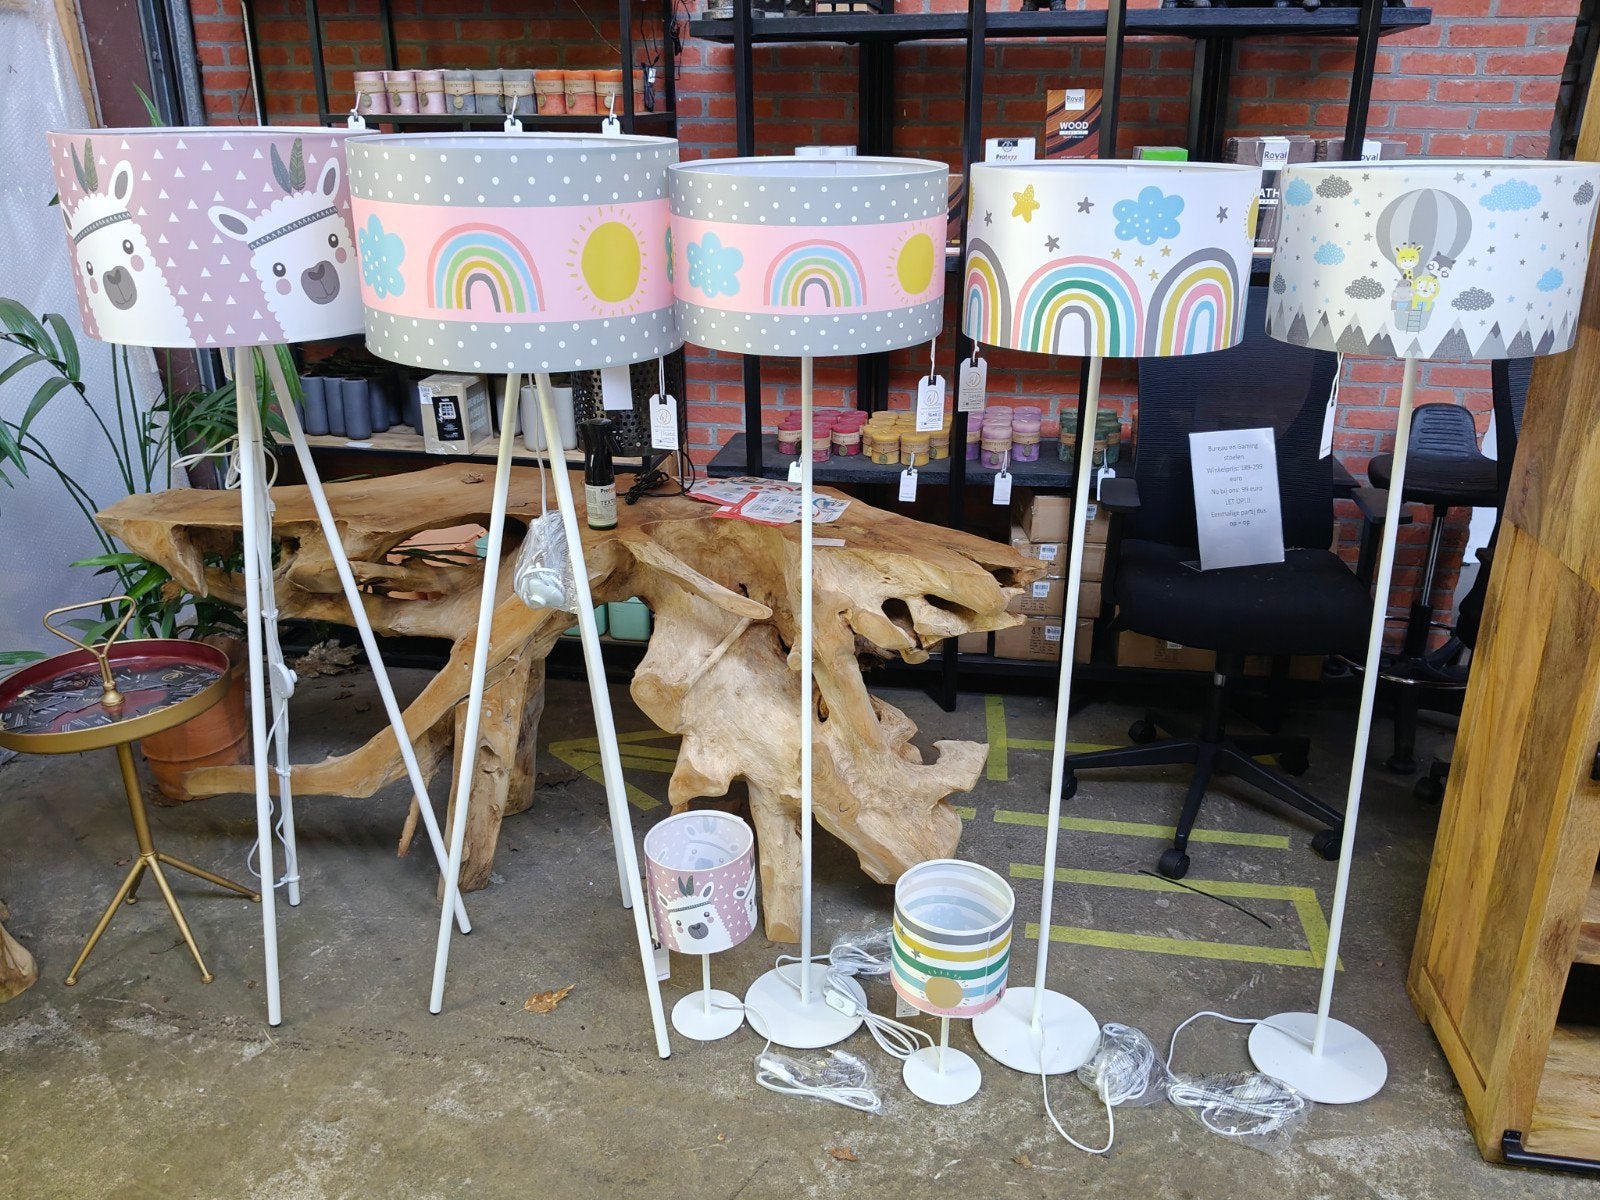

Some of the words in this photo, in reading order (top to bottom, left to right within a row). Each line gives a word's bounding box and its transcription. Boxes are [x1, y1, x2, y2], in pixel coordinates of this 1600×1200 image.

[1060, 122, 1089, 130] WOOD
[1264, 151, 1288, 160] Royal
[1238, 443, 1259, 451] Gaming
[1219, 488, 1228, 496] bij
[1211, 510, 1240, 518] Eenmalige
[1241, 508, 1256, 518] partij
